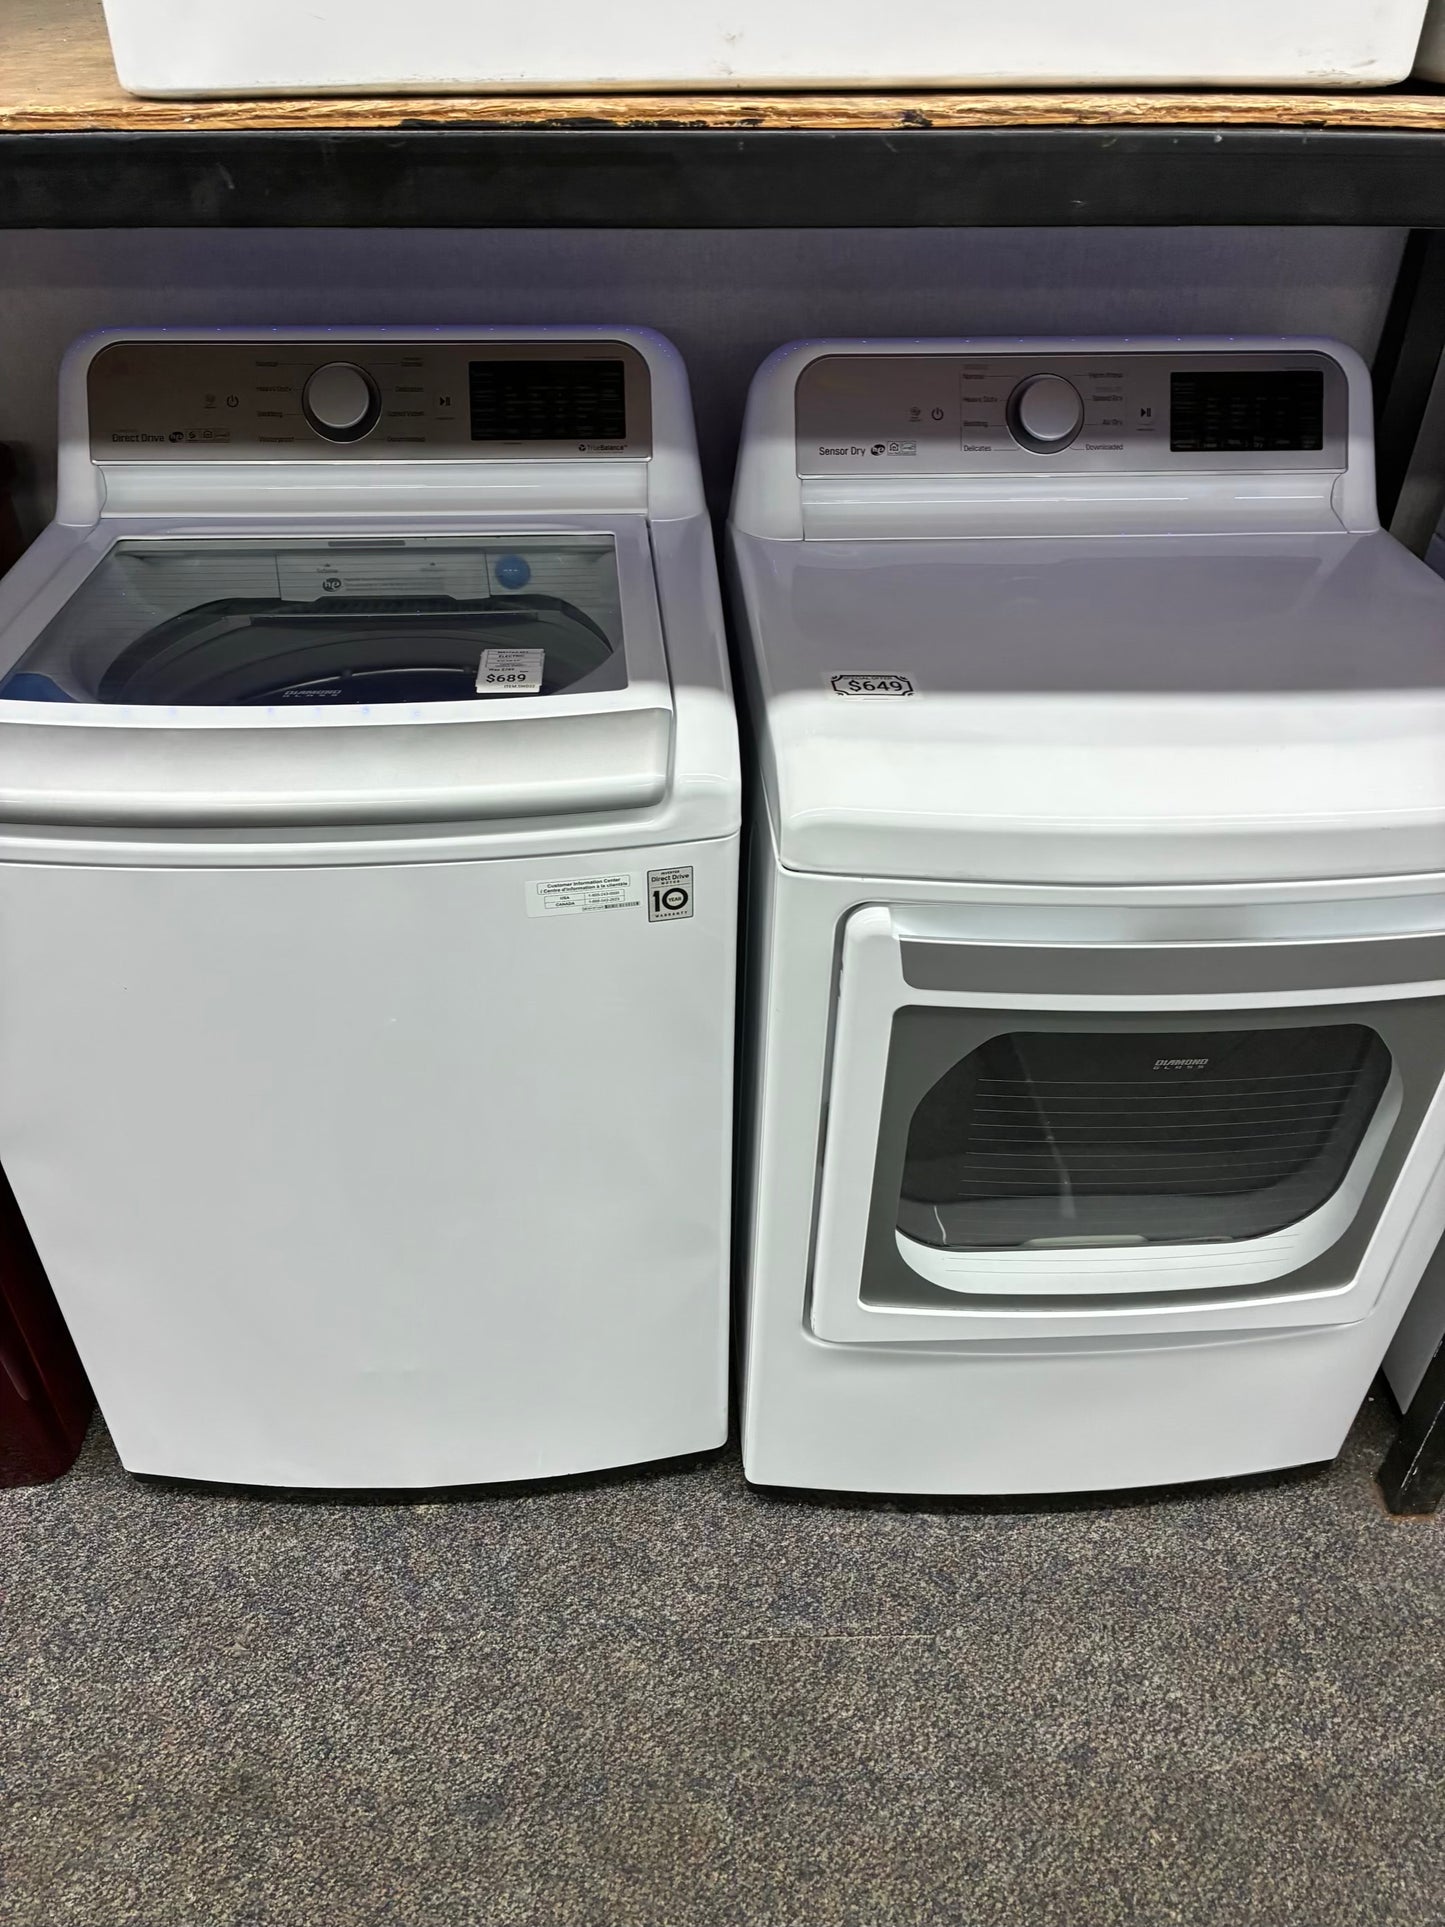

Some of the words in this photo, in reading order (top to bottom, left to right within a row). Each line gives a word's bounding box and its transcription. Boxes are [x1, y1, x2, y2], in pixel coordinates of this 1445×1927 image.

[111, 433, 140, 443] Direct
[141, 433, 165, 443] Drive
[819, 446, 849, 456] Sensor
[850, 446, 866, 456] Dry
[485, 673, 526, 684] $689
[848, 679, 903, 692] $649
[547, 881, 573, 889] Customer
[652, 887, 689, 913] 10
[1154, 1058, 1209, 1066] DIAMOND
